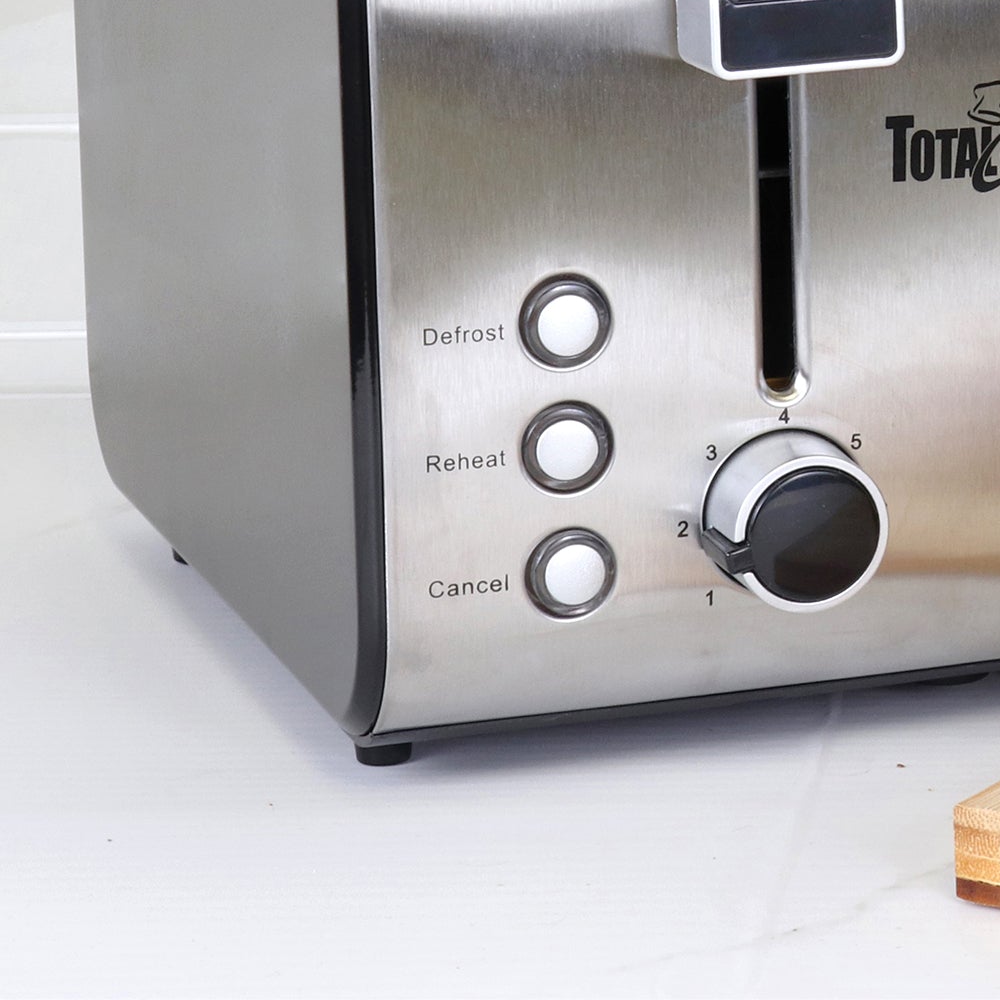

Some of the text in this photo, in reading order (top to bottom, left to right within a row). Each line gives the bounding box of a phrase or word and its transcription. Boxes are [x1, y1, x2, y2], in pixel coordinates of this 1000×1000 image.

[423, 324, 504, 346] Defrost
[778, 408, 790, 424] 4
[850, 433, 862, 450] 5
[426, 450, 506, 473] Reheat
[706, 445, 717, 461] 3
[677, 521, 689, 538] 2
[429, 574, 509, 599] Cancel
[705, 590, 713, 606] 1
